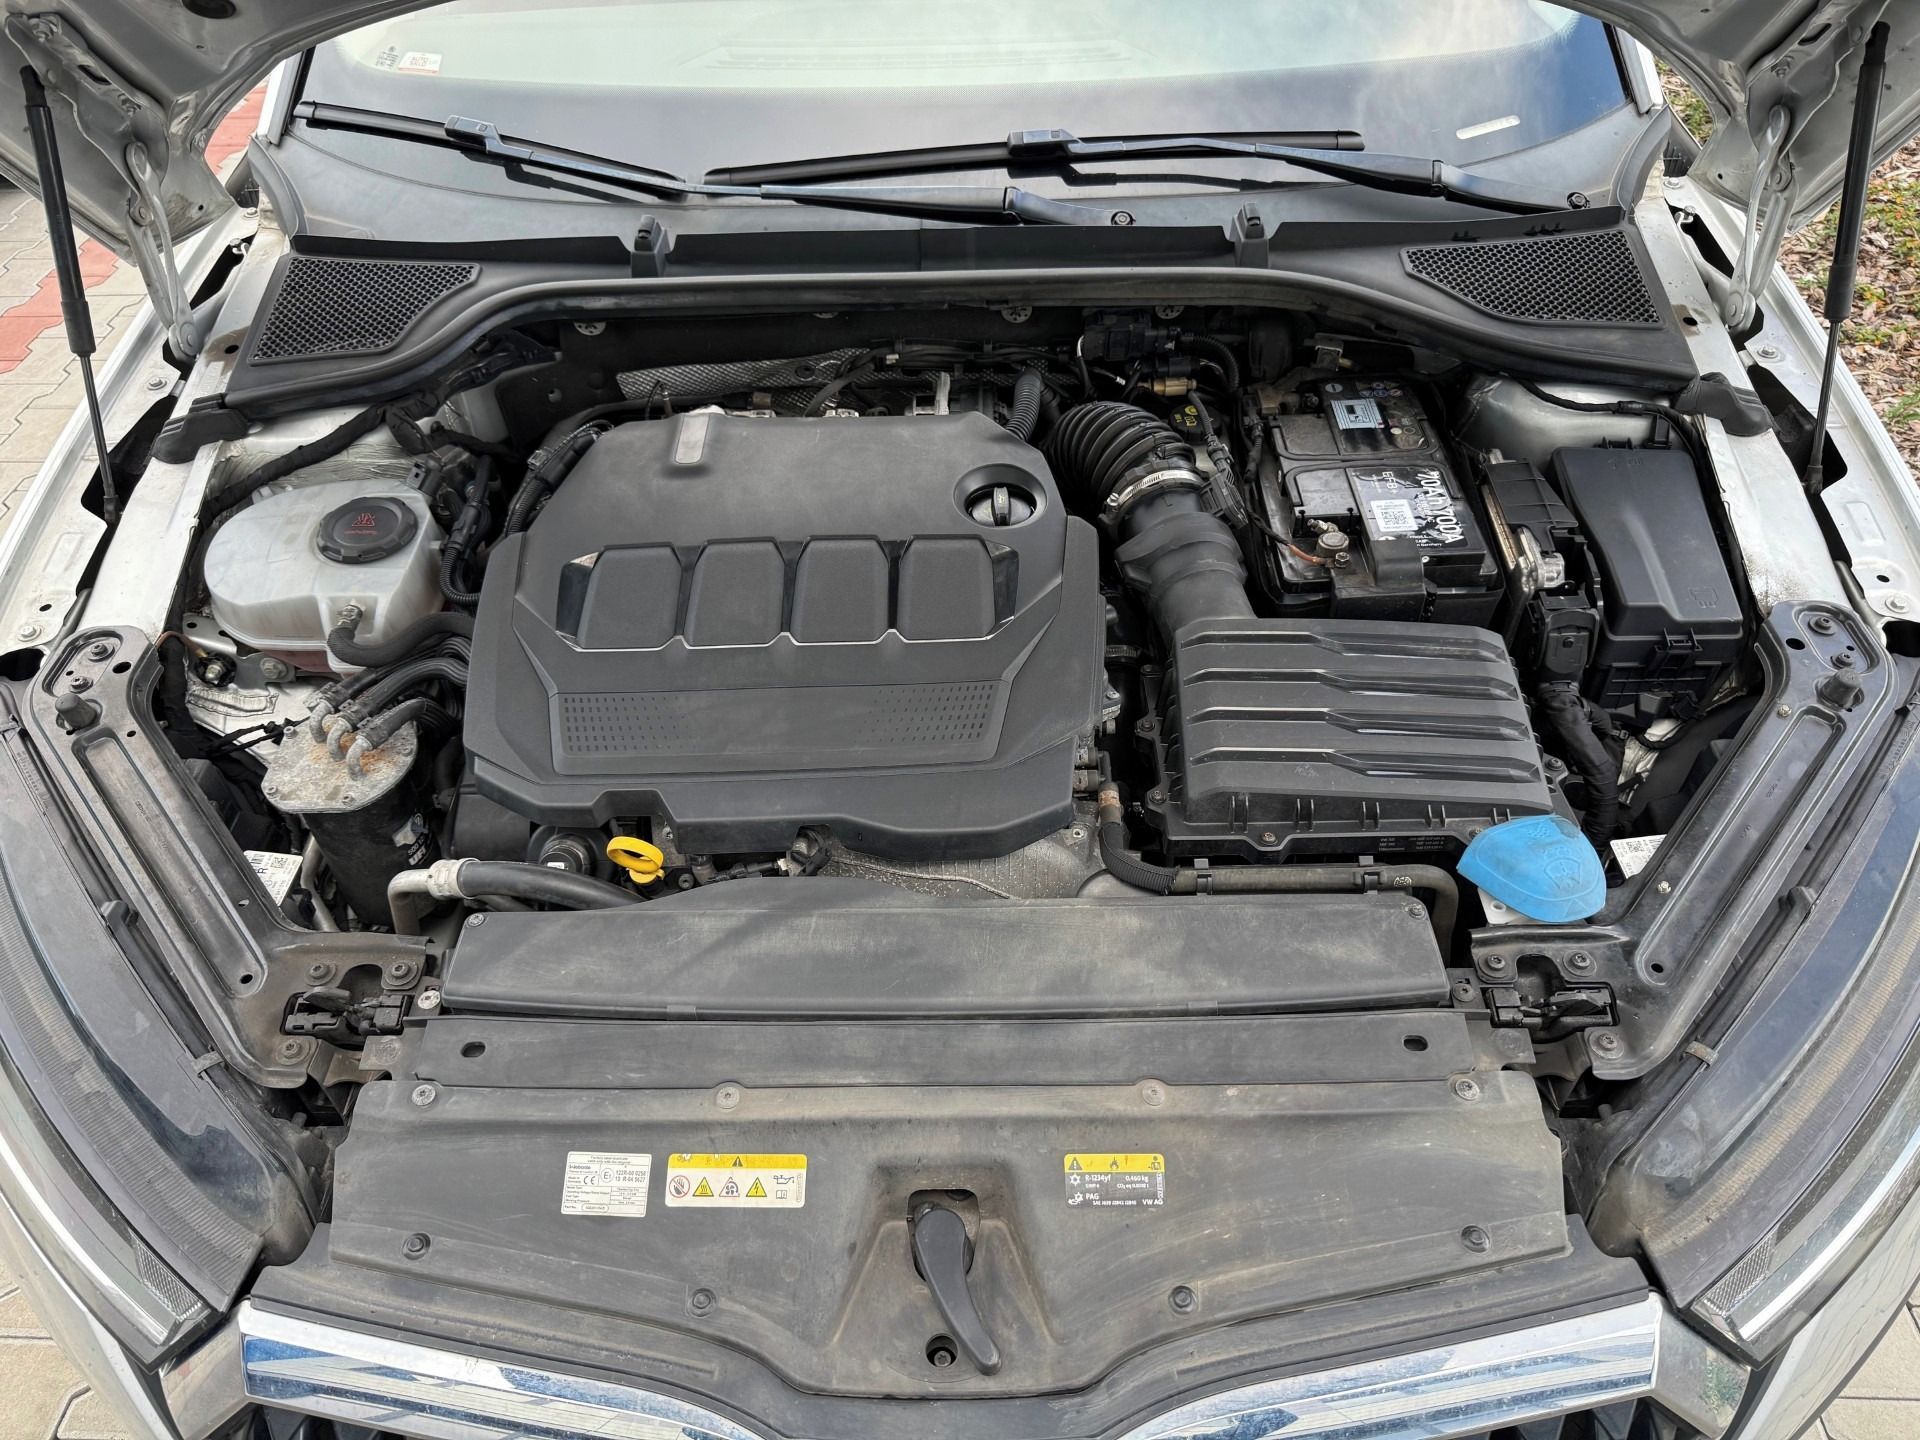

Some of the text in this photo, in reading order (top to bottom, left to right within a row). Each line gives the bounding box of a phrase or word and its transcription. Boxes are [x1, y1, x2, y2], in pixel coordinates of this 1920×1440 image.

[1085, 1174, 1111, 1183] R-1234yf
[1085, 1192, 1100, 1201] PAG
[1142, 1198, 1153, 1206] VW
